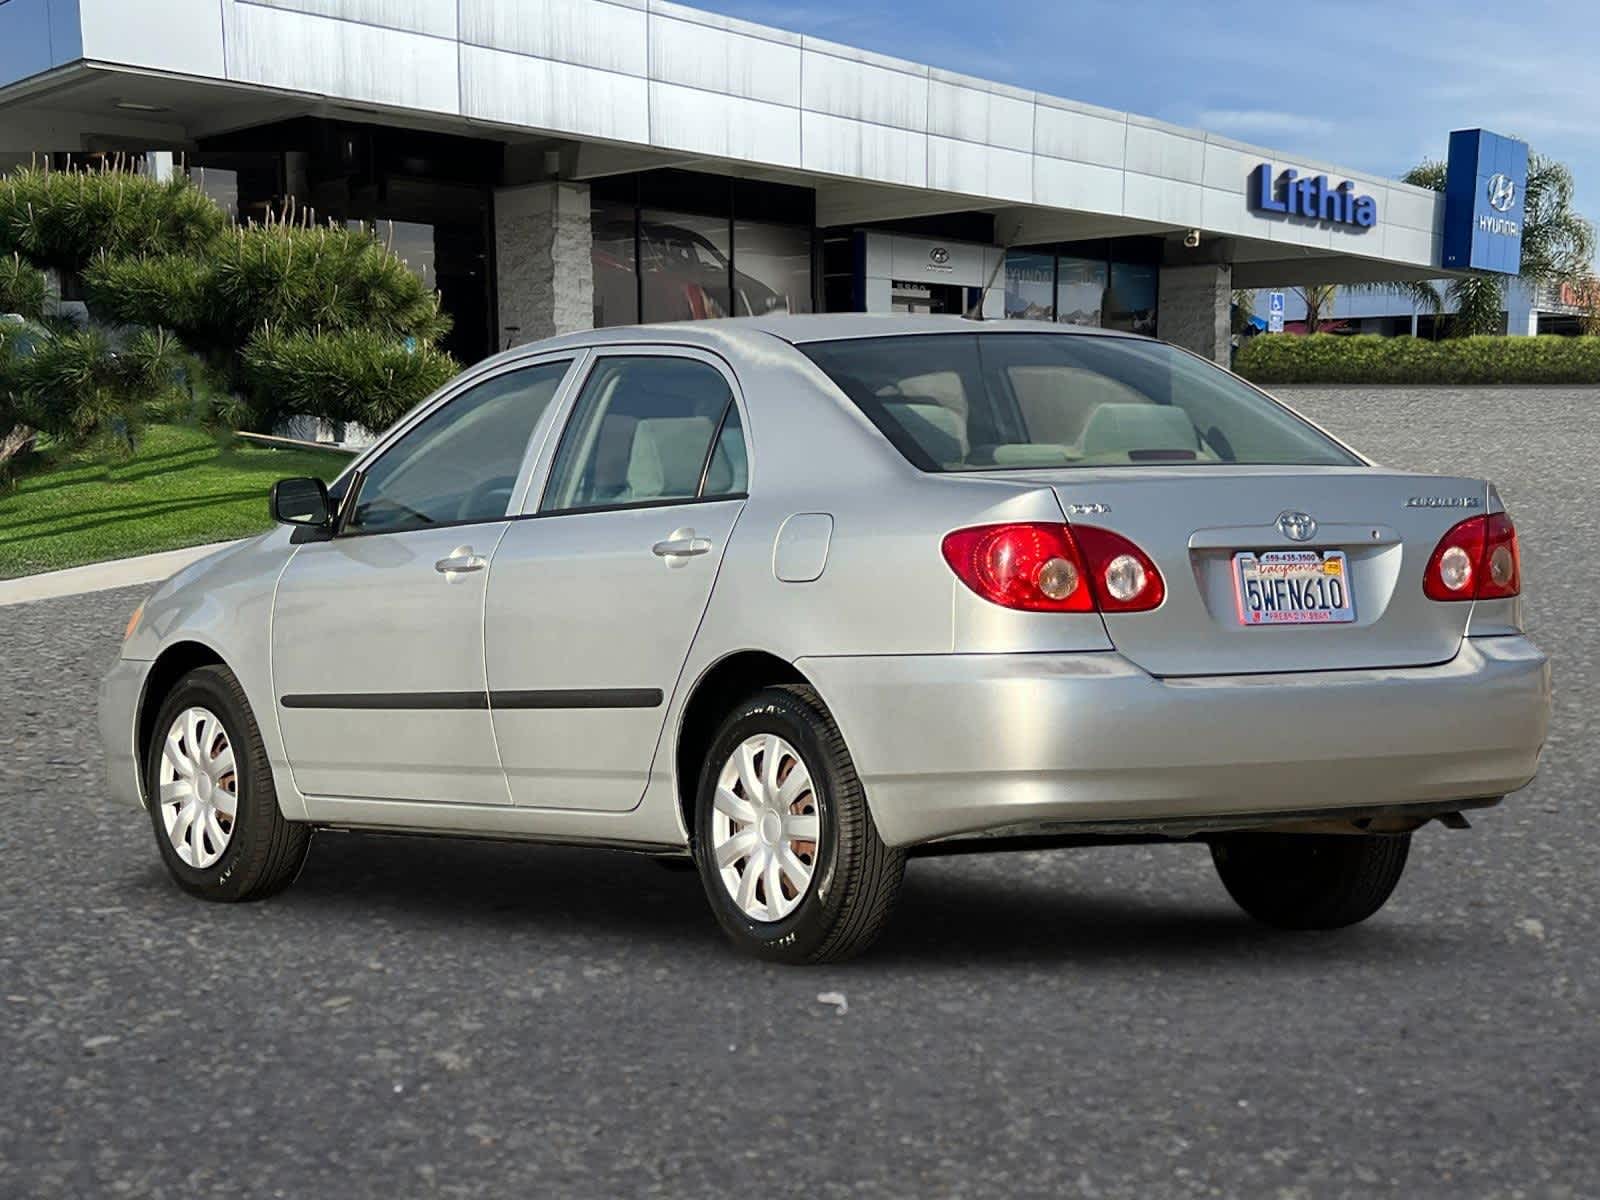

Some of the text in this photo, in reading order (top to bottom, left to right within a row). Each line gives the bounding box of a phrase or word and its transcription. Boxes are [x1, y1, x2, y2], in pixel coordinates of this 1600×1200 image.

[1254, 163, 1377, 228] Lithia
[1479, 214, 1520, 238] HYUNDAI
[1246, 577, 1344, 611] 5WFN610
